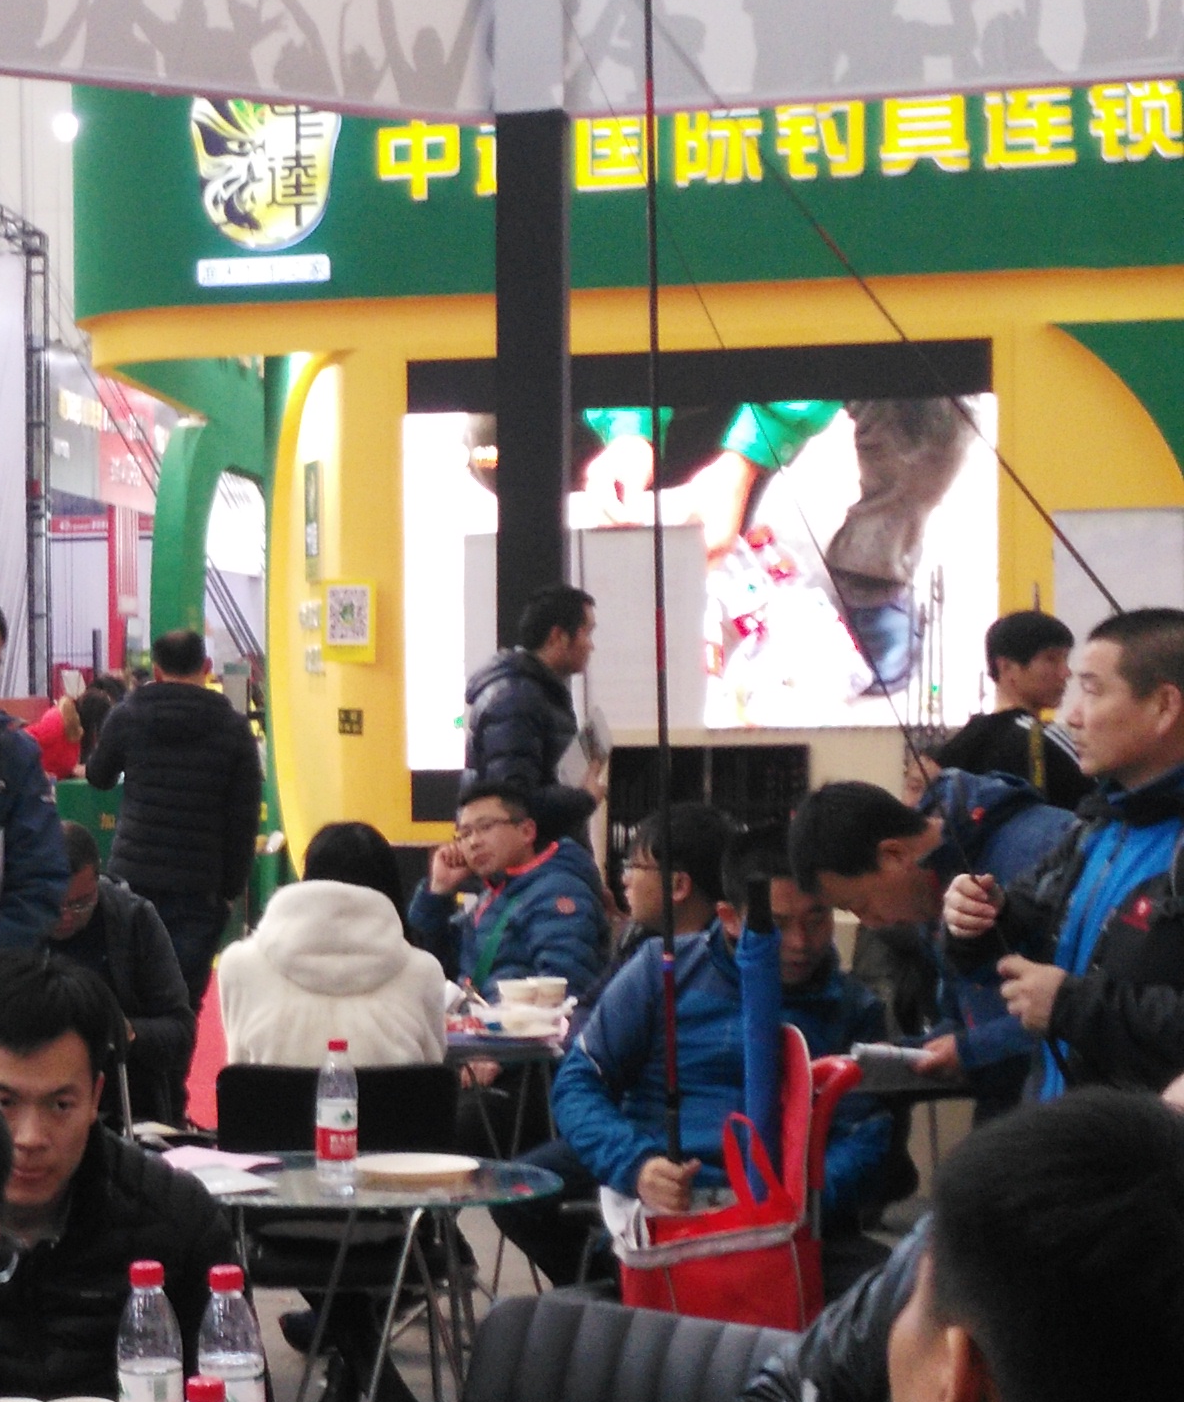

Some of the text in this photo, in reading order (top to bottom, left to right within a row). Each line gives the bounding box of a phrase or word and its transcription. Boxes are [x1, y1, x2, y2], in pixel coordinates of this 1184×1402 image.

[377, 80, 1183, 201] 中国际钓具连锁
